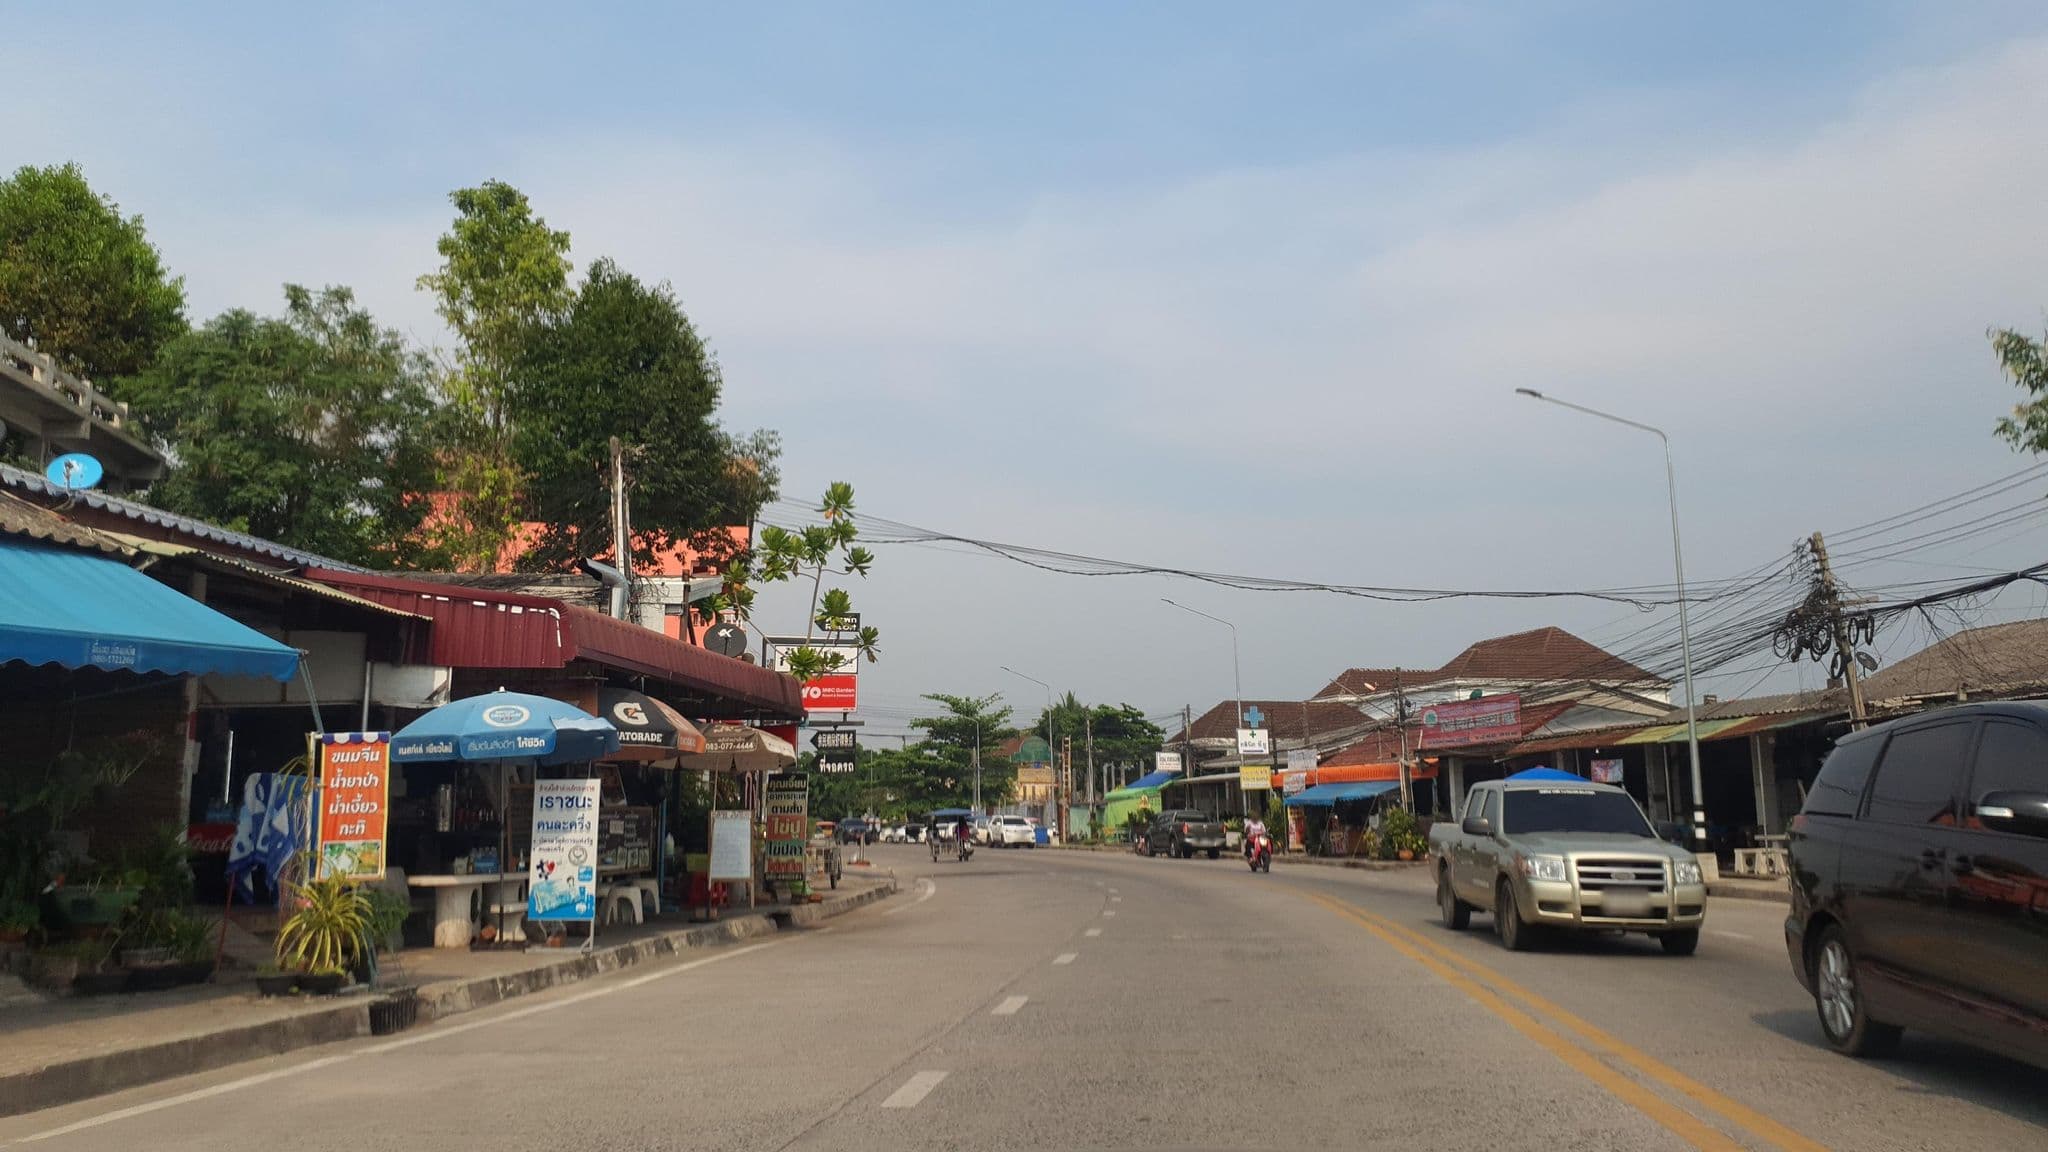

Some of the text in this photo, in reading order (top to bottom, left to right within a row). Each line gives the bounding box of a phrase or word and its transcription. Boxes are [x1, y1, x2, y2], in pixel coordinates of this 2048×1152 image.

[617, 731, 662, 743] ATORADE
[331, 746, 380, 763] ขนมจีน
[820, 754, 854, 773] ที่จอดรถ
[330, 768, 379, 788] น้ำยาป่า
[328, 794, 378, 815] น้ำเงี้ยว
[540, 795, 593, 809] เราชนะ
[339, 820, 366, 835] กะทิ
[537, 813, 592, 831] คนละครึ่ง
